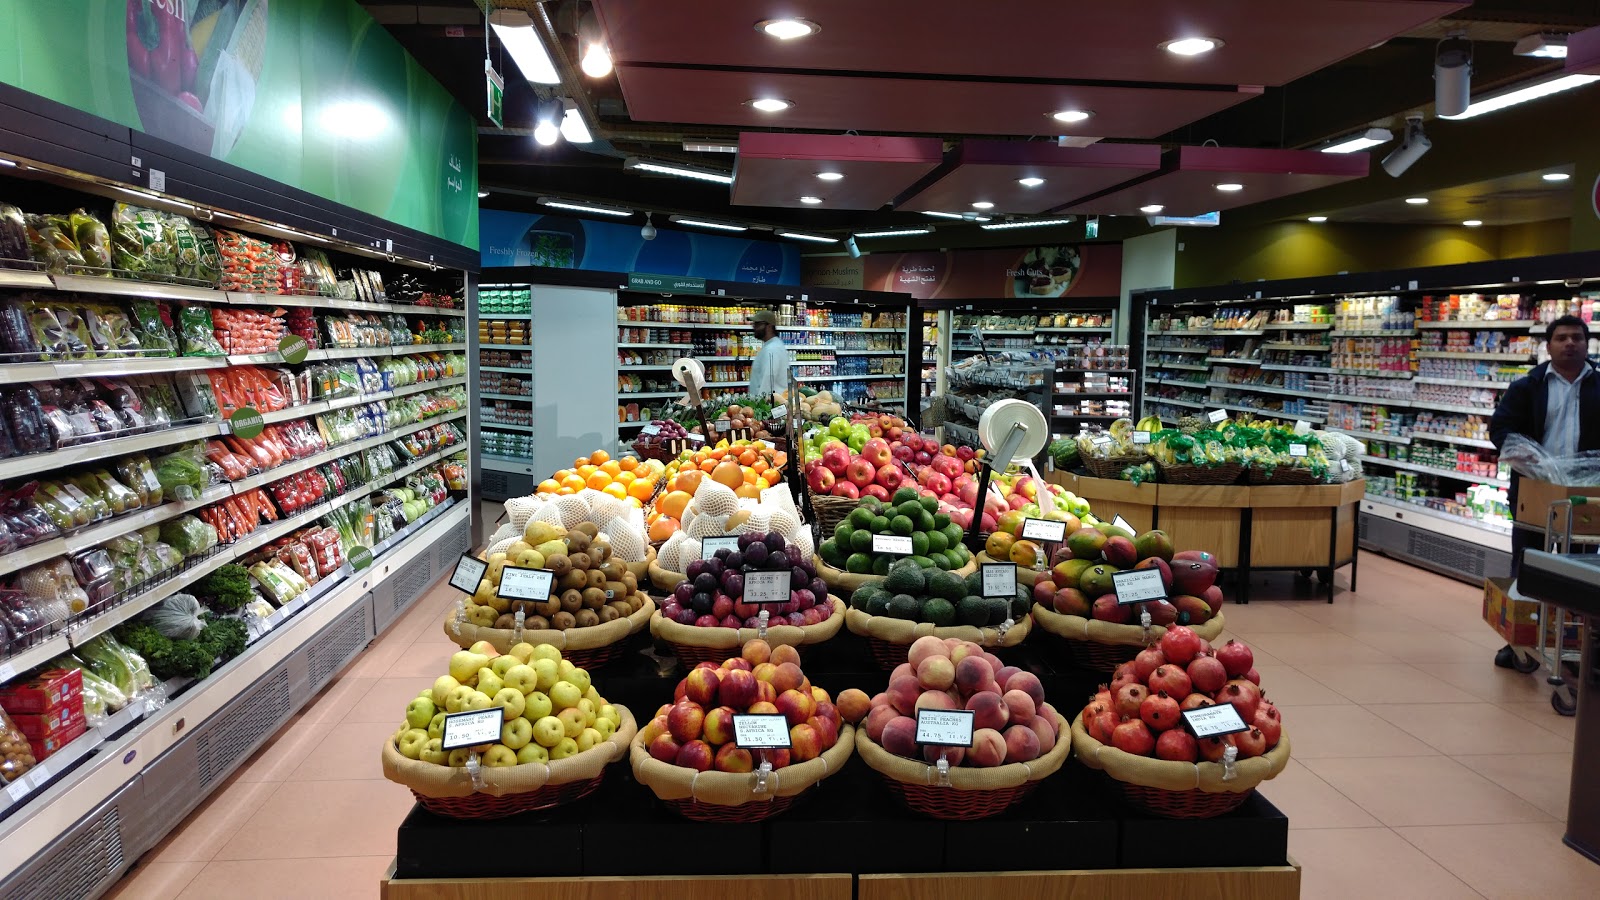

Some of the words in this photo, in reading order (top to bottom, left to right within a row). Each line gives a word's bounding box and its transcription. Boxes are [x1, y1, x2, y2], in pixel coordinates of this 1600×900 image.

[489, 246, 514, 257] Freshly
[516, 248, 539, 257] Frozen
[1006, 269, 1025, 277] Fresh
[1026, 268, 1043, 276] Cuts
[281, 340, 306, 356] ORGANIC
[234, 416, 263, 428] ORGANIC
